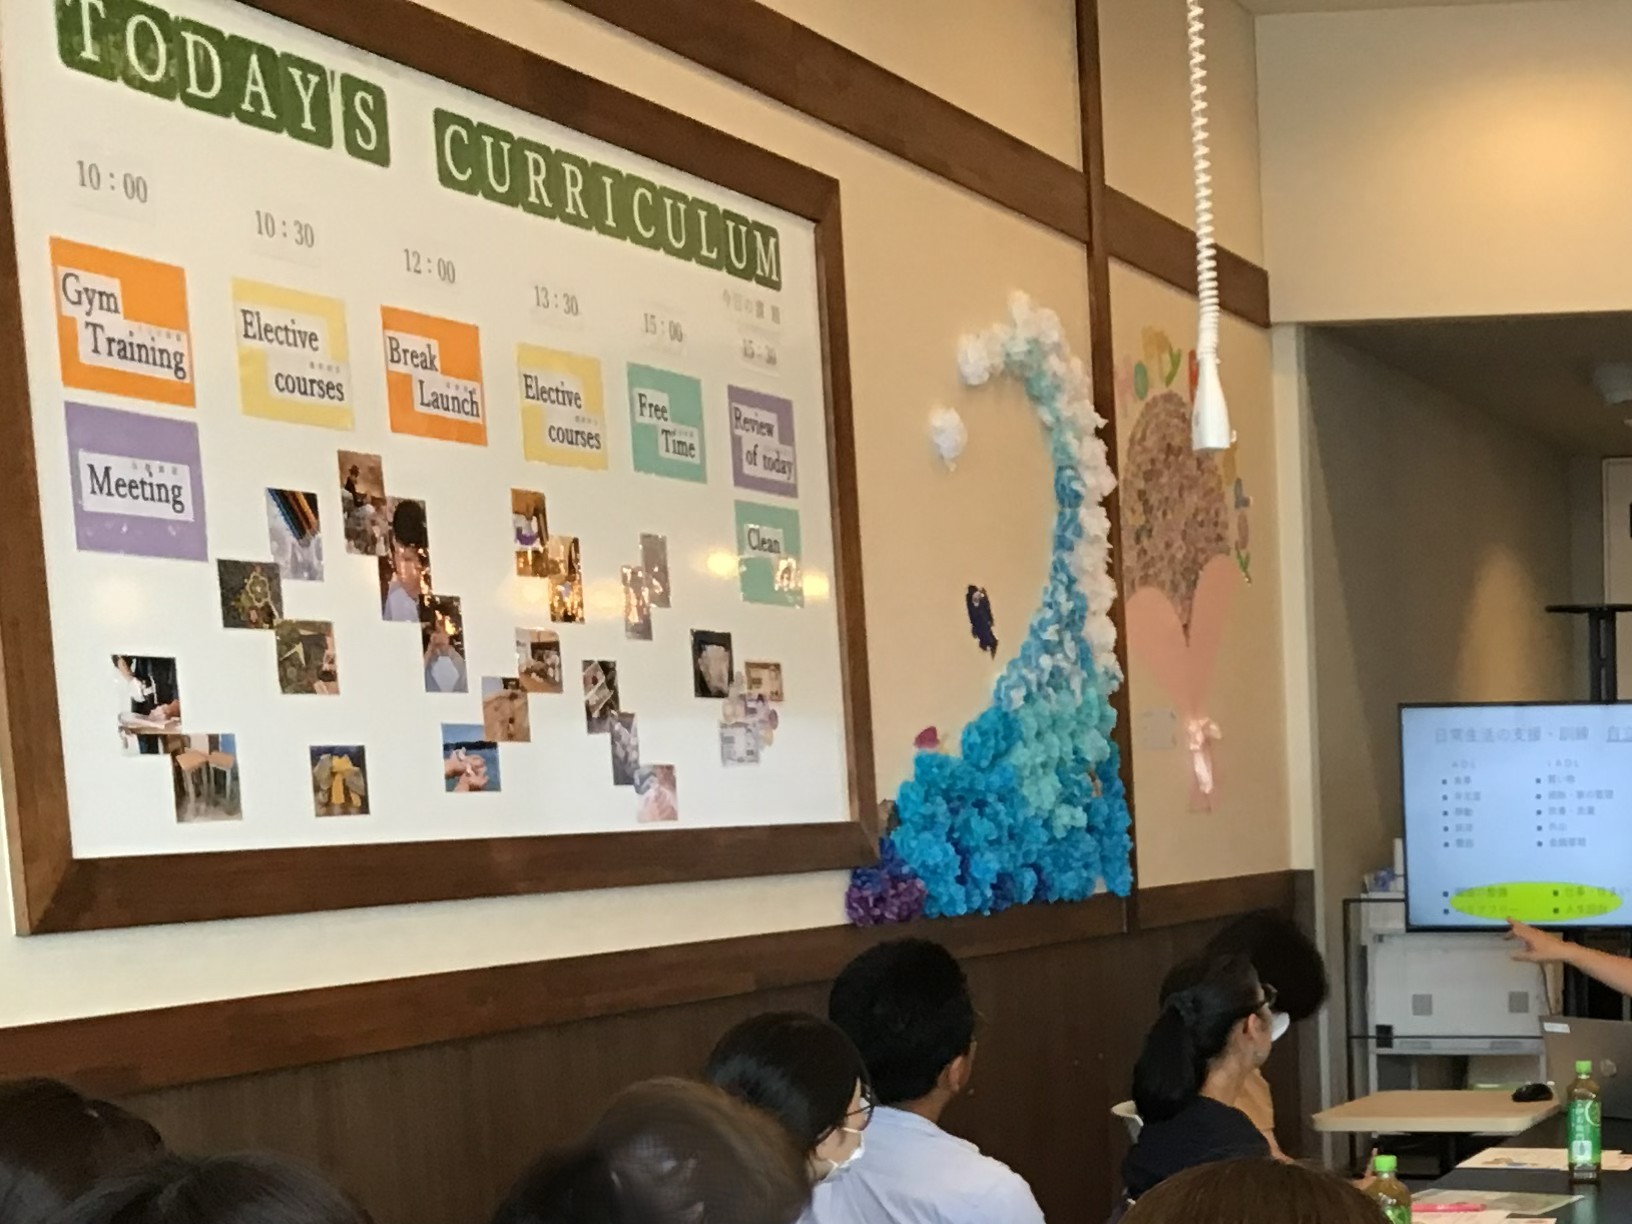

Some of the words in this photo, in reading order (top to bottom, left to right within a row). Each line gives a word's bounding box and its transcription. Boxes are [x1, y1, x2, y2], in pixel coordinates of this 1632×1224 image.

[443, 124, 781, 282] CURRICULUM
[61, 271, 121, 317] Gym
[240, 308, 320, 352] Elective
[84, 320, 187, 381] Training
[387, 335, 439, 373] Break
[274, 371, 346, 403] courses
[418, 378, 481, 419] Launch
[522, 373, 582, 410] Elective
[637, 392, 669, 422] Free
[732, 406, 776, 438] Review
[547, 424, 602, 451] courses
[661, 428, 696, 459] Time
[745, 443, 759, 467] of
[762, 451, 794, 480] today
[86, 463, 186, 515] Meeting
[747, 527, 781, 554] Clean
